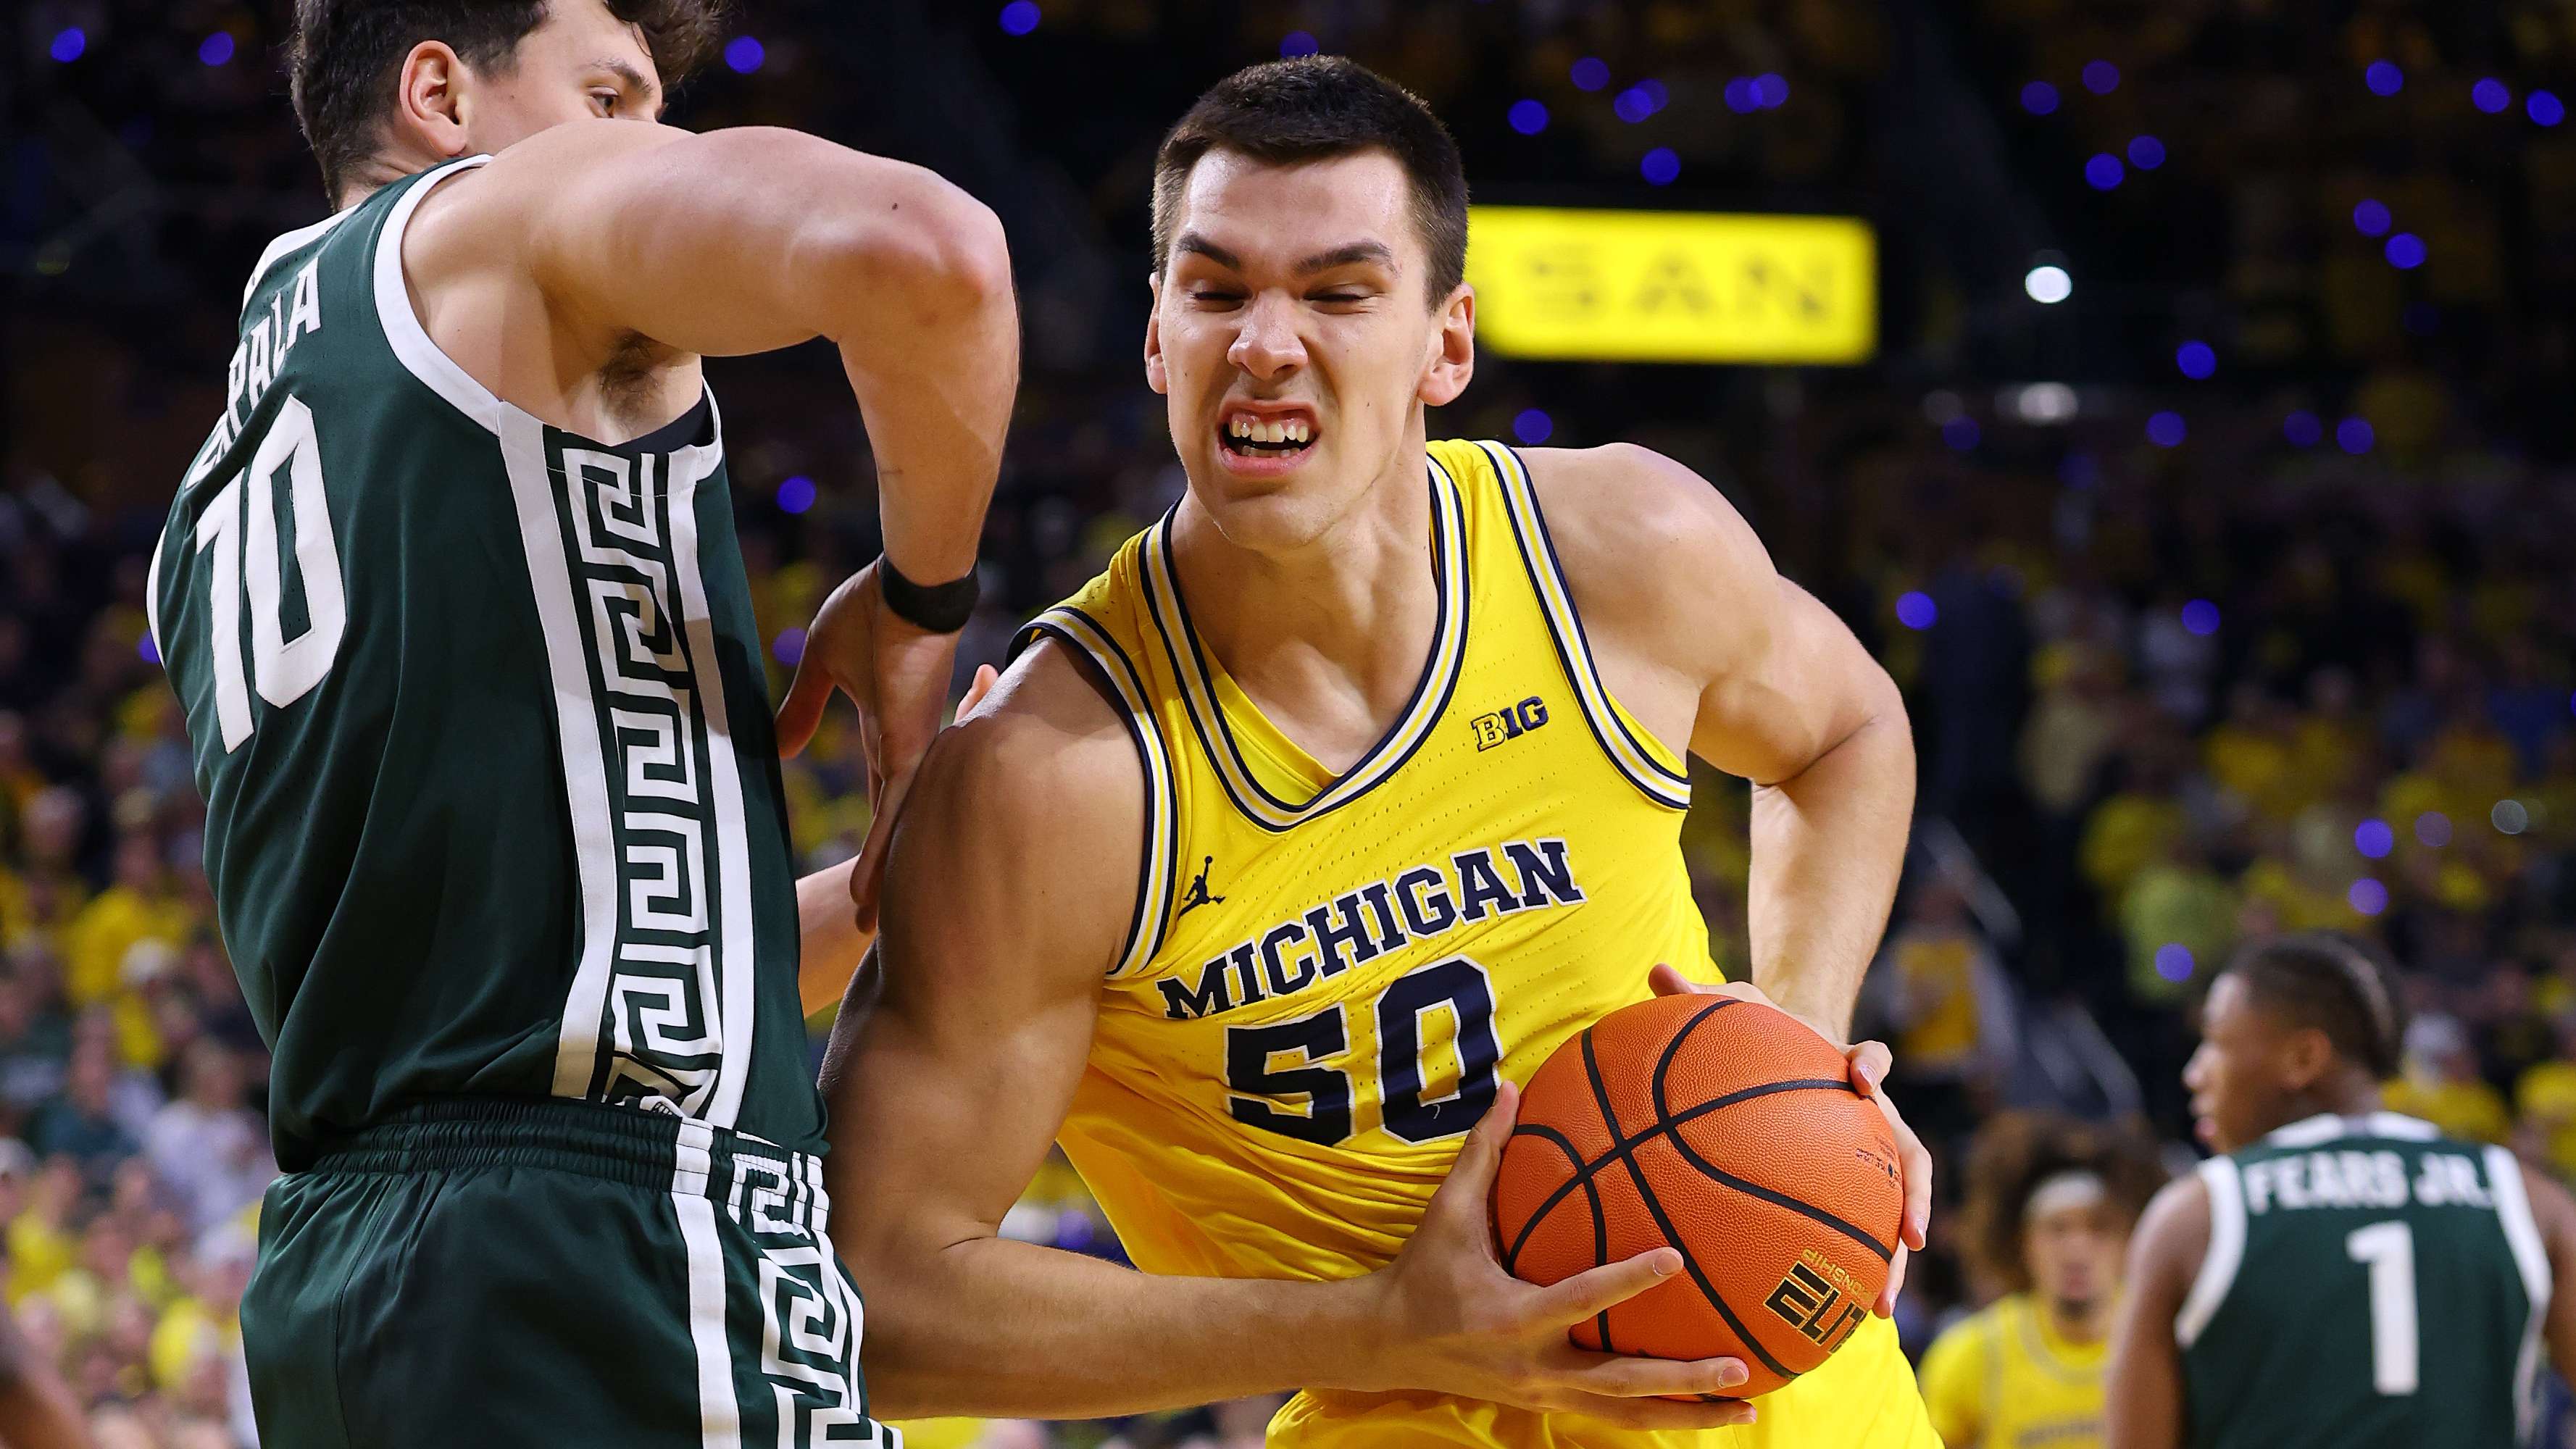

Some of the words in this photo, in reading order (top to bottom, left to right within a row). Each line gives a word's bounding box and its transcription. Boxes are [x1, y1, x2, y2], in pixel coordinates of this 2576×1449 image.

[1467, 243, 1835, 325] SAN
[196, 393, 347, 754] 10
[1156, 837, 1589, 1020] MICHIGAN
[1223, 953, 1504, 1148] 50
[2243, 1150, 2409, 1215] FEARS
[1762, 1260, 1868, 1355] ELIT
[2345, 1220, 2420, 1397] 1
